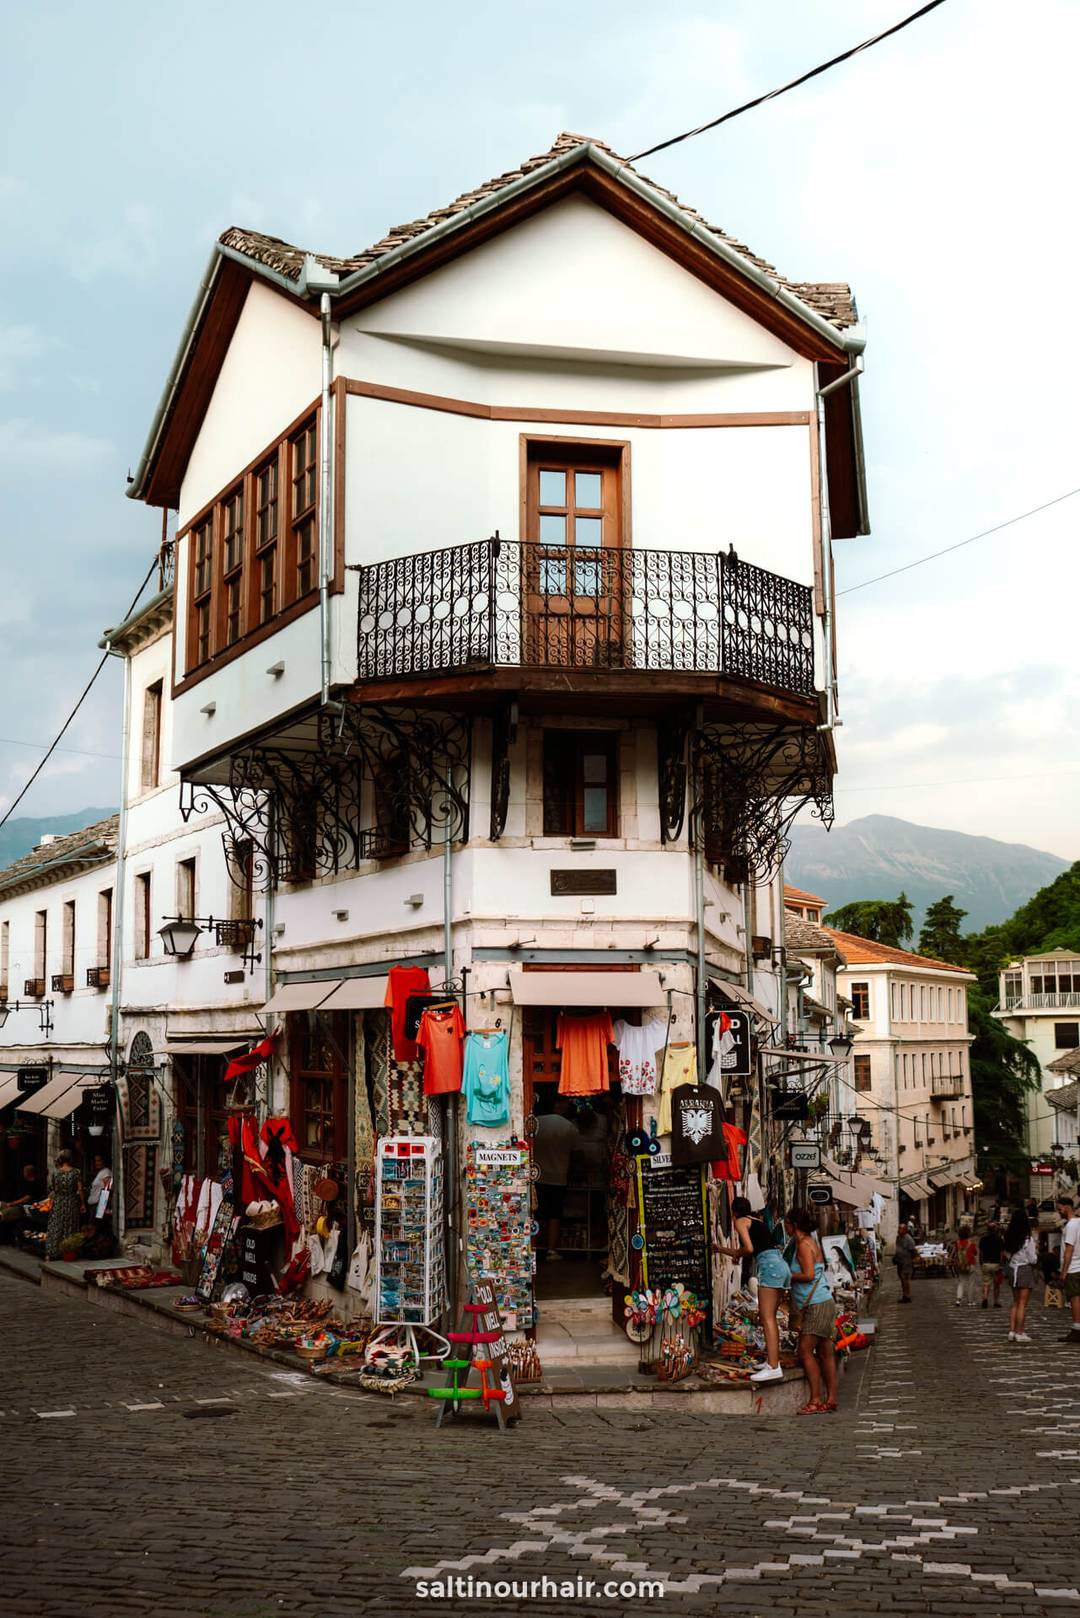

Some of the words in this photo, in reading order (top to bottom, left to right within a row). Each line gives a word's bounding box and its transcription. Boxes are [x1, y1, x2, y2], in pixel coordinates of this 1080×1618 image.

[712, 1019, 741, 1029] OD
[479, 1153, 518, 1162] MAGNETS
[653, 1155, 672, 1164] SILVE
[246, 1238, 256, 1249] OLD
[245, 1251, 257, 1264] WELL
[479, 1285, 493, 1305] OLD
[483, 1311, 500, 1331] WELL
